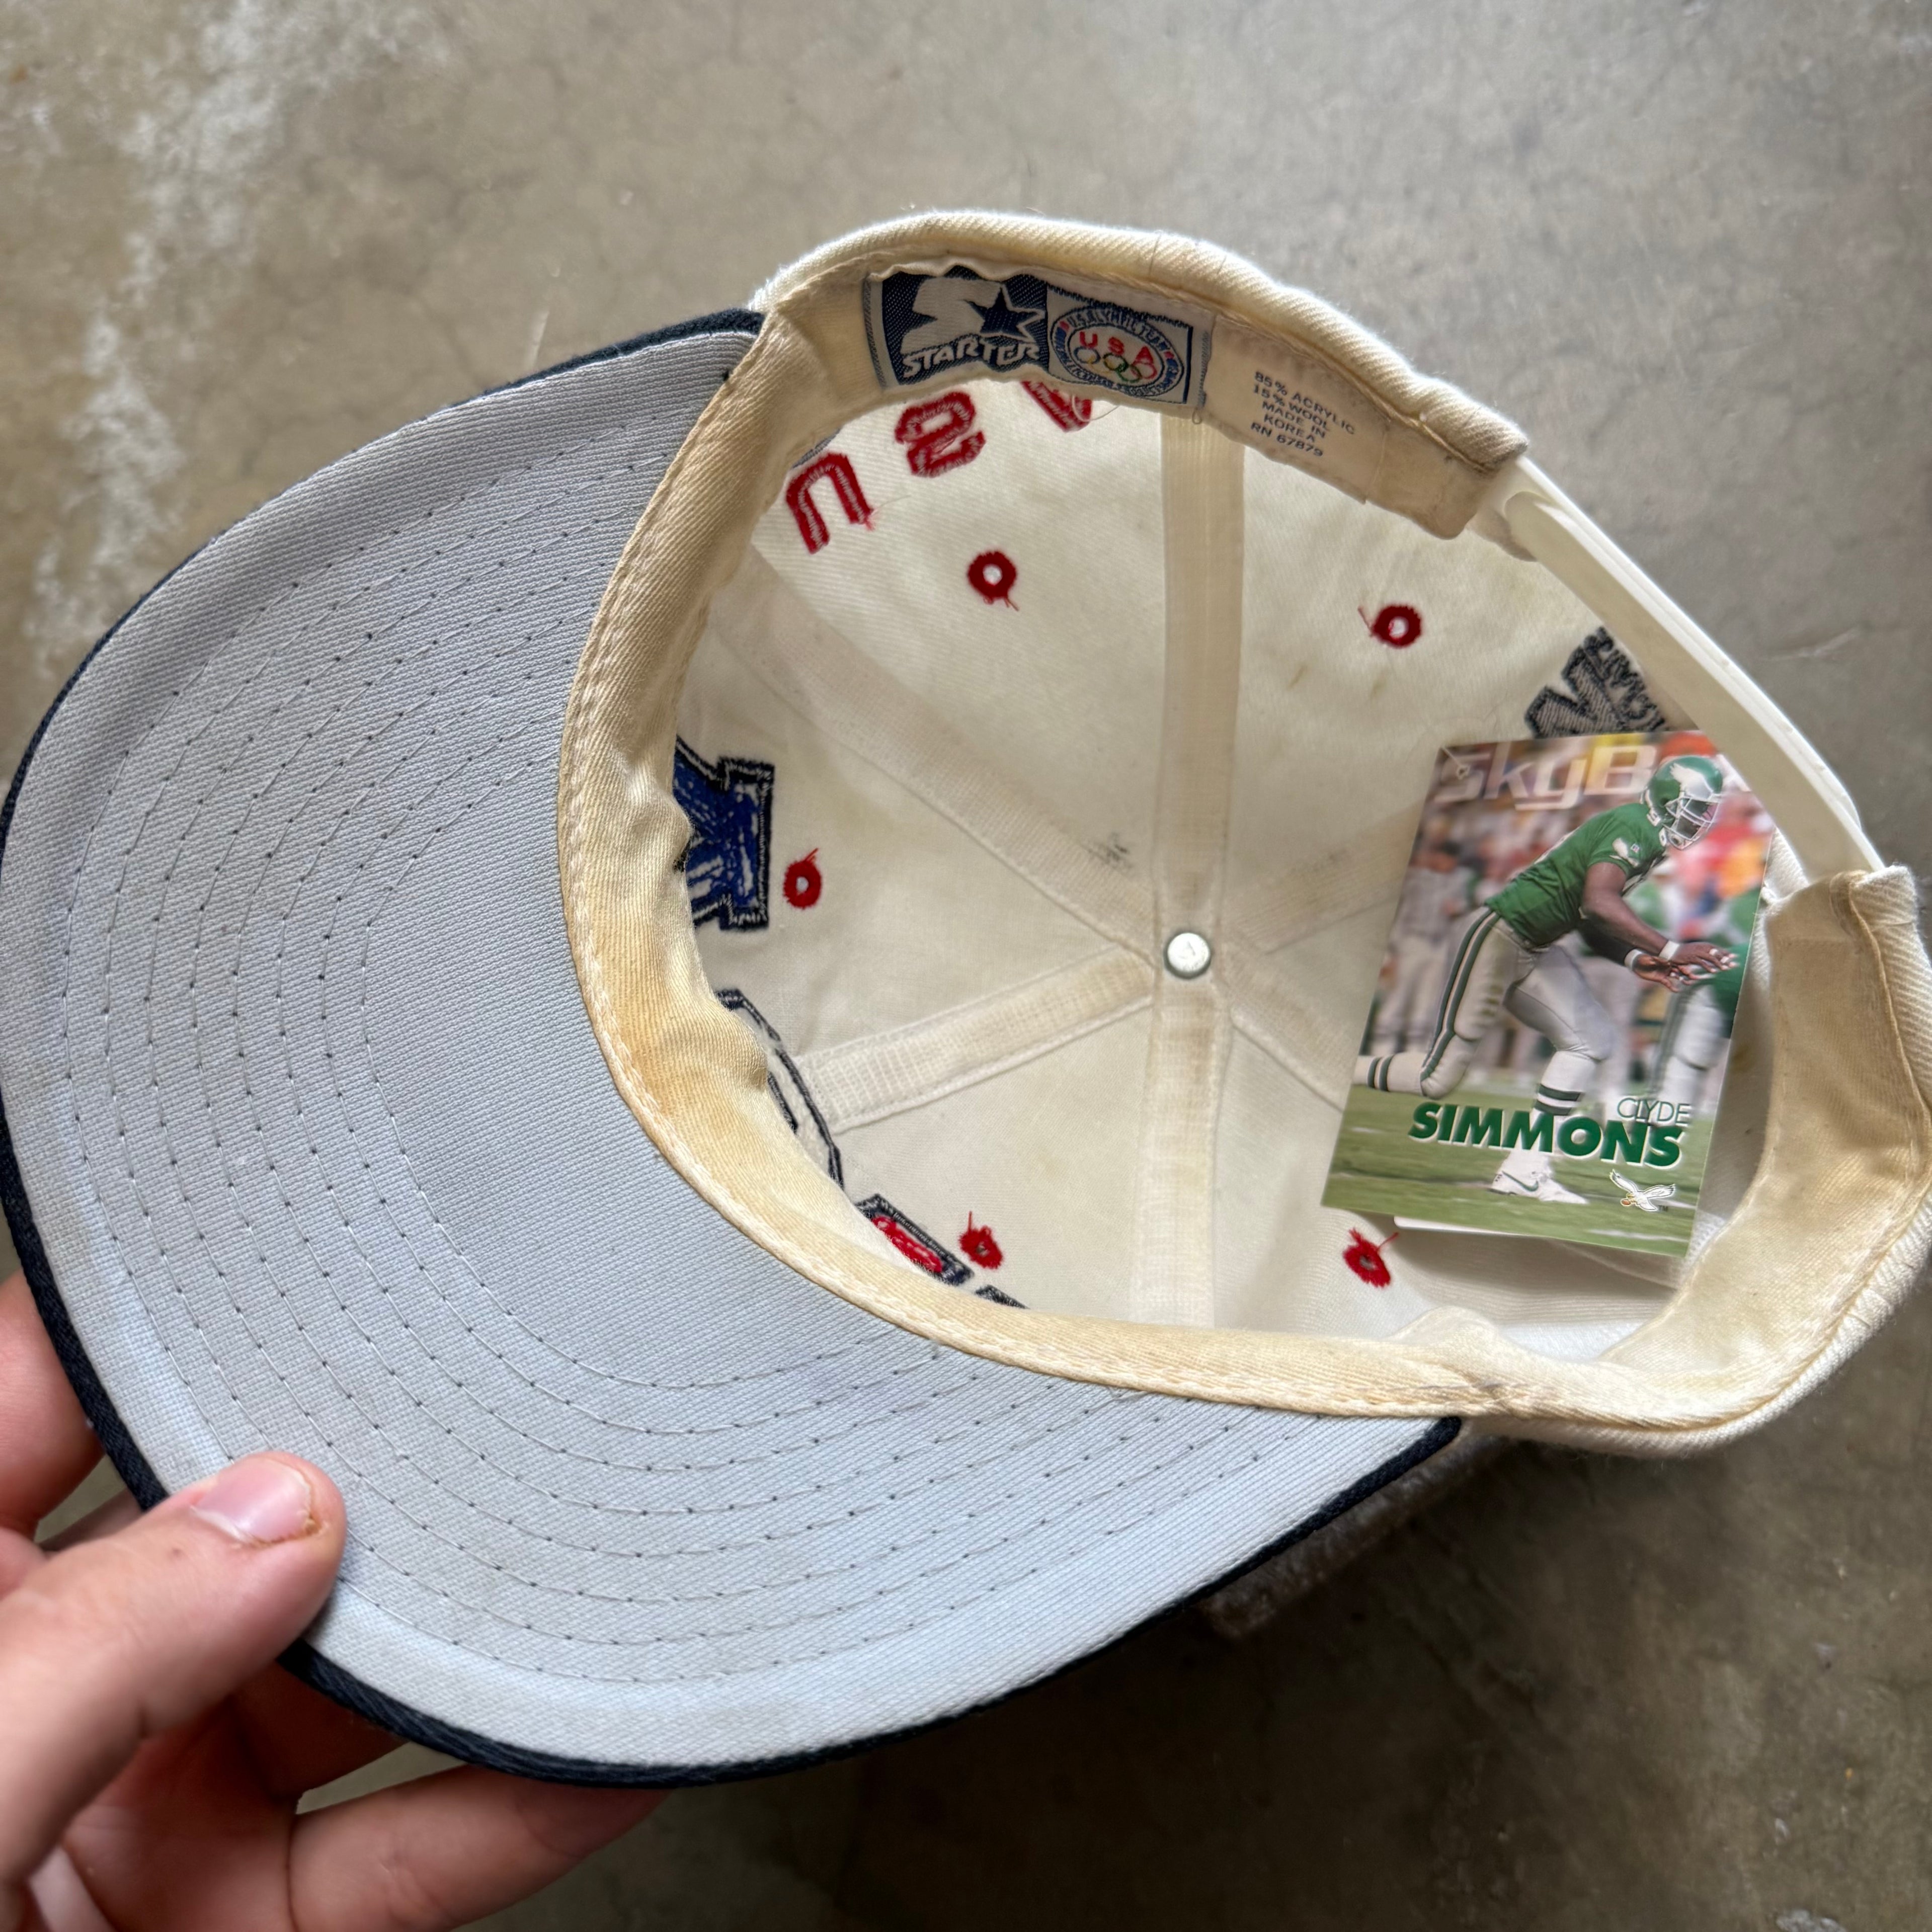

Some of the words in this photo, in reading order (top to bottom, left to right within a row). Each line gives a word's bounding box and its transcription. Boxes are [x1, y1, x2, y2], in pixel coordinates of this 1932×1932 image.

[904, 334, 1041, 378] STARTER
[1253, 385, 1284, 407] 15%
[1289, 403, 1331, 432] WOOL
[1254, 371, 1287, 396] 85%
[1292, 393, 1355, 435] ACRYLIC
[1262, 401, 1305, 427] MADE
[1311, 427, 1326, 439] IN
[1251, 422, 1272, 438] RN
[1276, 434, 1323, 457] 67879
[1264, 414, 1315, 443] KOREA
[1433, 740, 1658, 811] SkyB
[1617, 1096, 1692, 1128] CLYDE
[1408, 1101, 1686, 1170] SIMMONS
